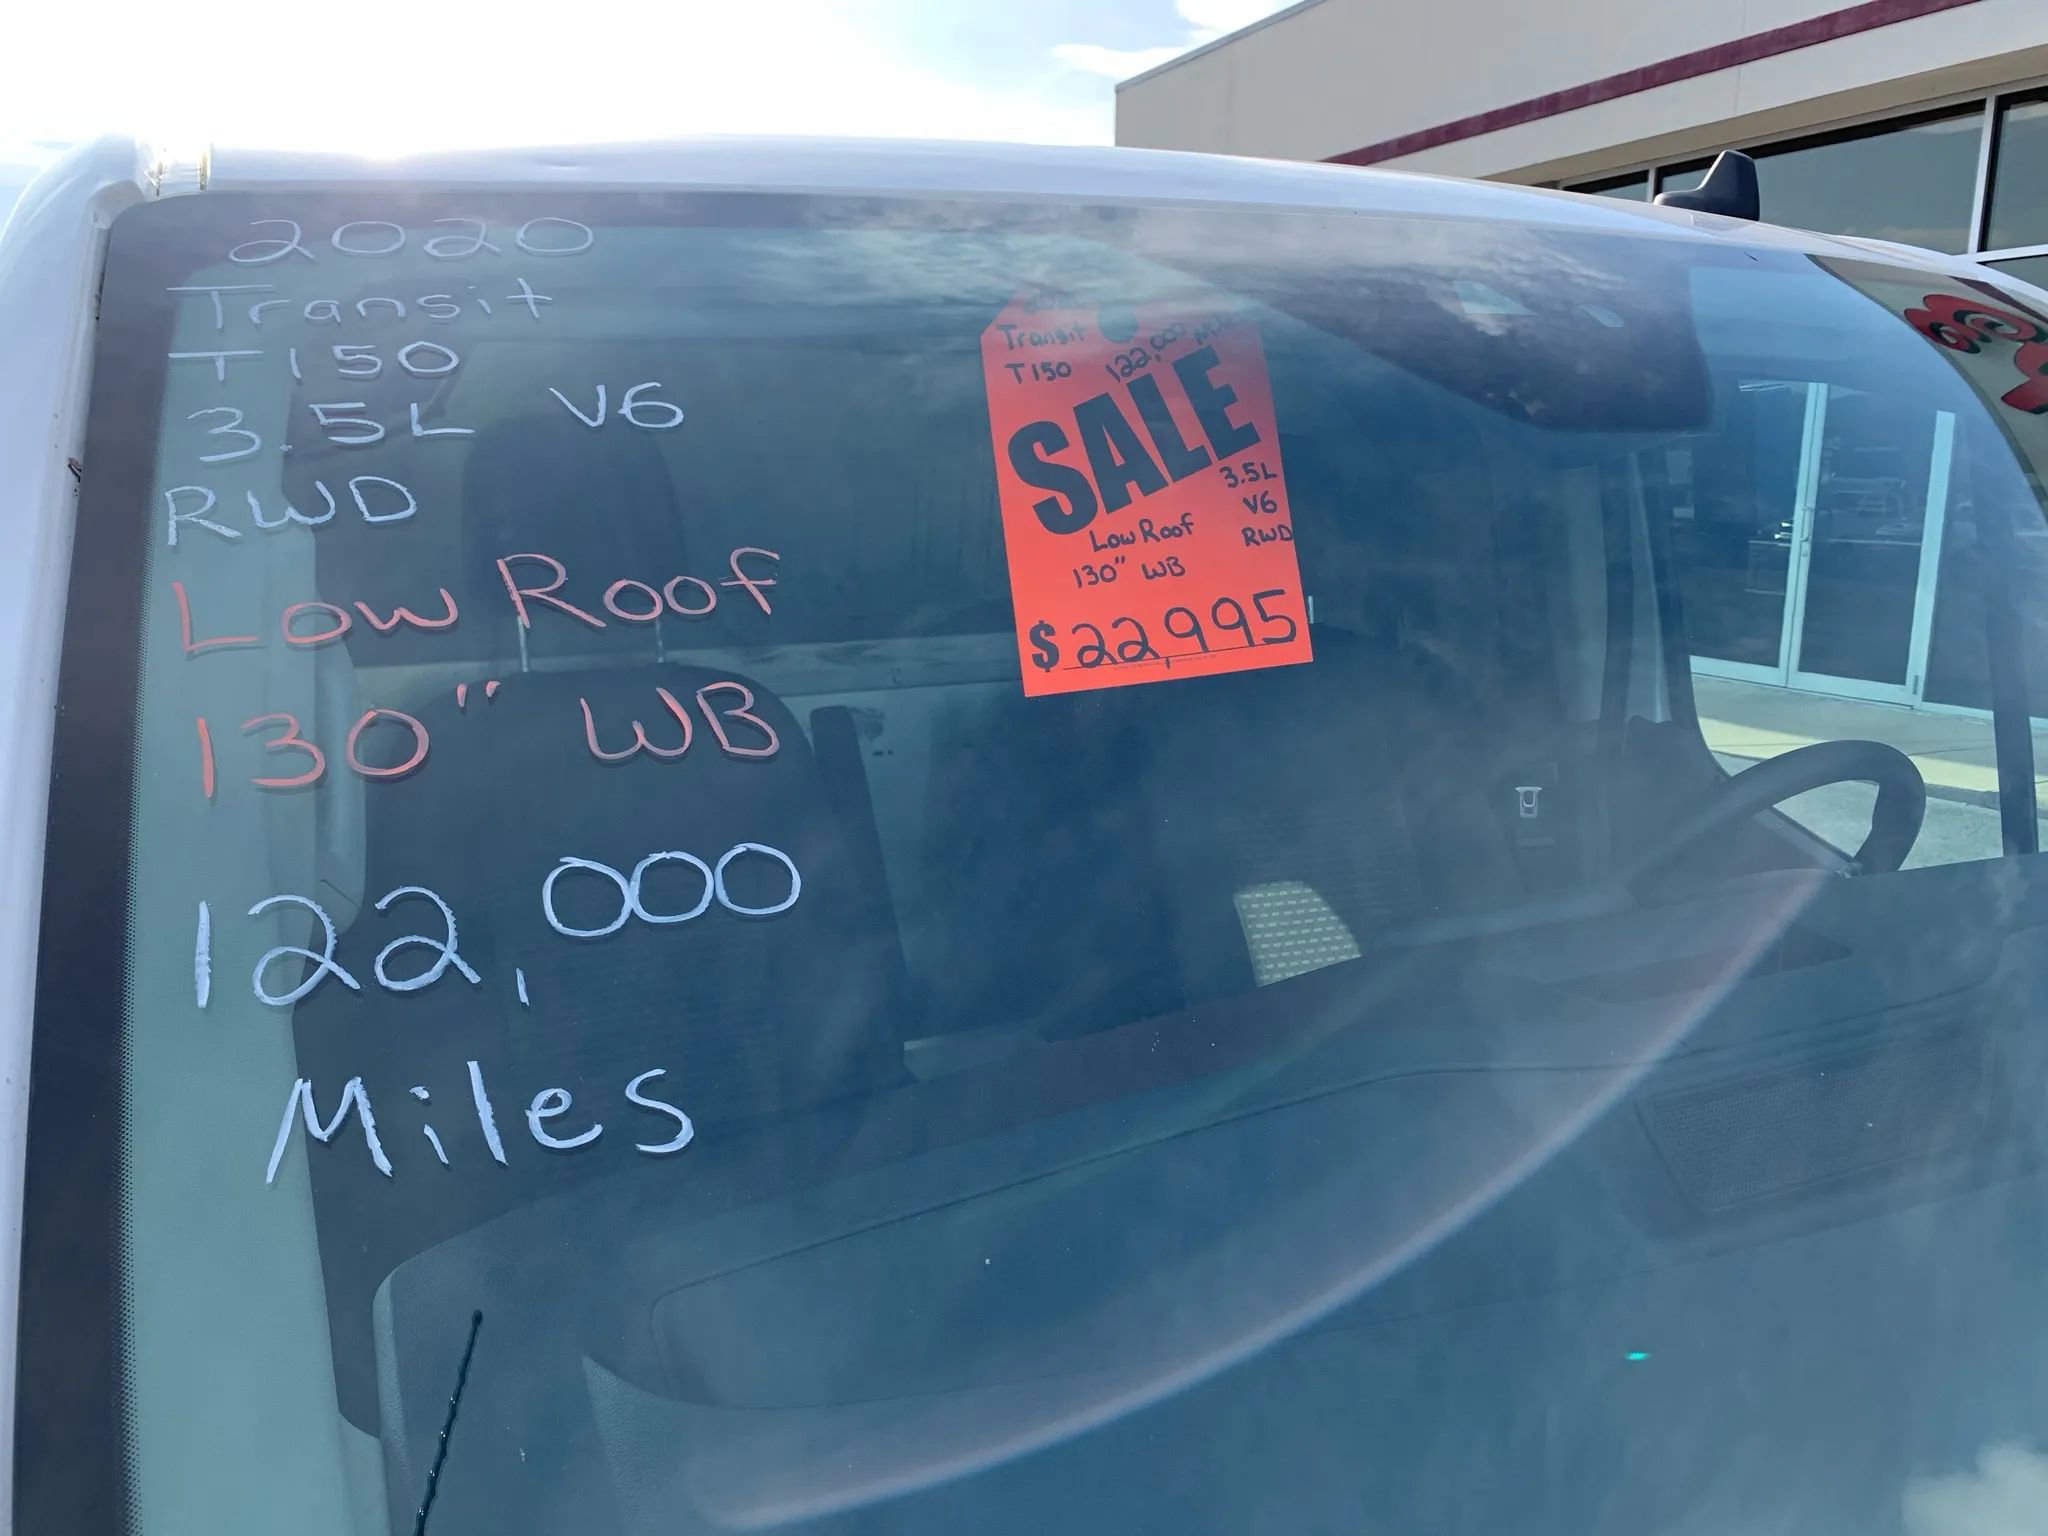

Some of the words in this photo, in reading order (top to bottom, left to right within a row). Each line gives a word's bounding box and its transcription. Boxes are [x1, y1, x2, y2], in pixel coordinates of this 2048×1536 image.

[228, 217, 594, 265] 2020
[166, 277, 552, 329] Transit
[167, 341, 460, 382] T150
[996, 321, 1087, 350] Transit
[1105, 321, 1186, 384] 122,000
[1005, 361, 1073, 385] T150
[187, 402, 476, 463] 3.5L
[548, 382, 685, 430] V6
[1007, 344, 1262, 535] SALE
[1219, 462, 1278, 489] 3.5L
[164, 475, 418, 546] RWD
[1242, 490, 1279, 515] V6
[1088, 529, 1137, 553] Low
[1138, 512, 1196, 544] Roof
[1241, 523, 1294, 549] RWD
[1140, 555, 1187, 582] WB
[172, 581, 459, 653] Low
[496, 546, 780, 628] Roof
[1028, 588, 1298, 674] $22,995
[580, 680, 781, 761] WB
[194, 842, 802, 1010] 122,000
[265, 1060, 695, 1186] Miles
